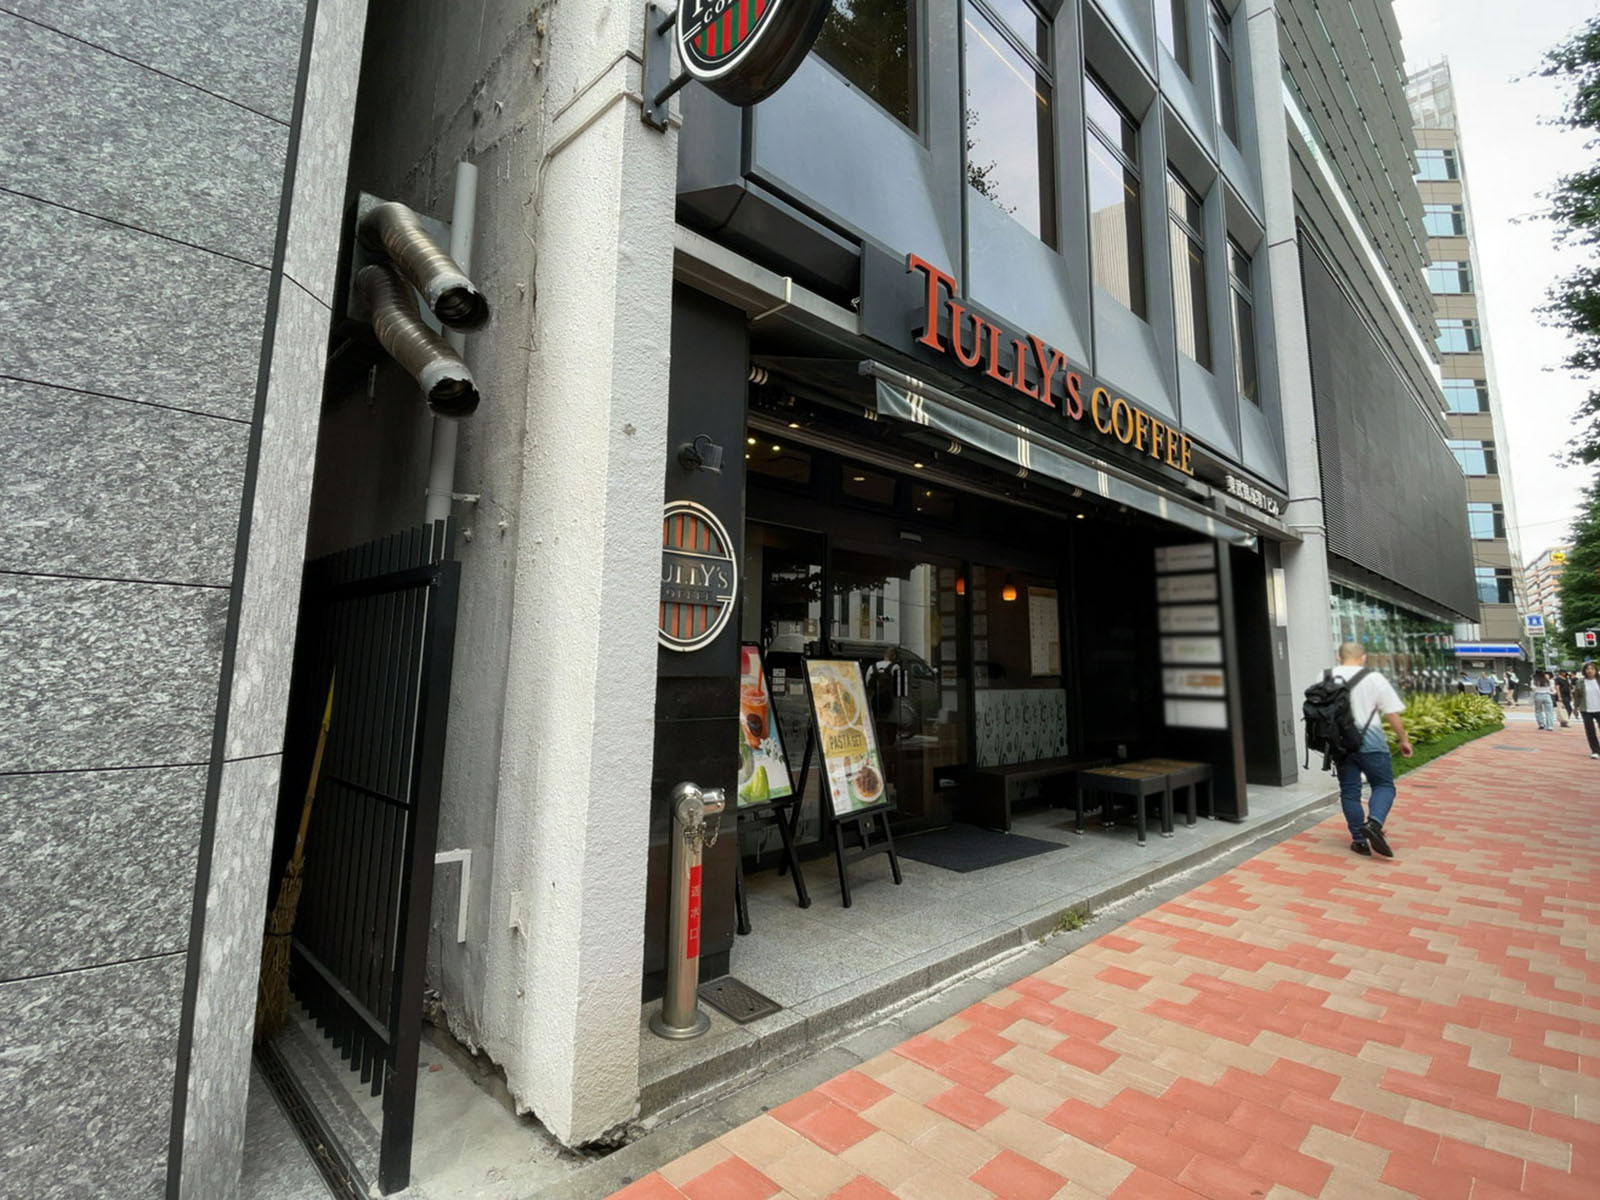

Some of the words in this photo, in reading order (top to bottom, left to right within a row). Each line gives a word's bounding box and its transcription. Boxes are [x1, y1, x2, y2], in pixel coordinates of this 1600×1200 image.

[906, 252, 1084, 421] TULLY'S
[1091, 386, 1195, 476] COFFEE
[661, 563, 729, 589] ULLY'S
[665, 588, 713, 601] OFFEE
[829, 733, 851, 750] PASTA
